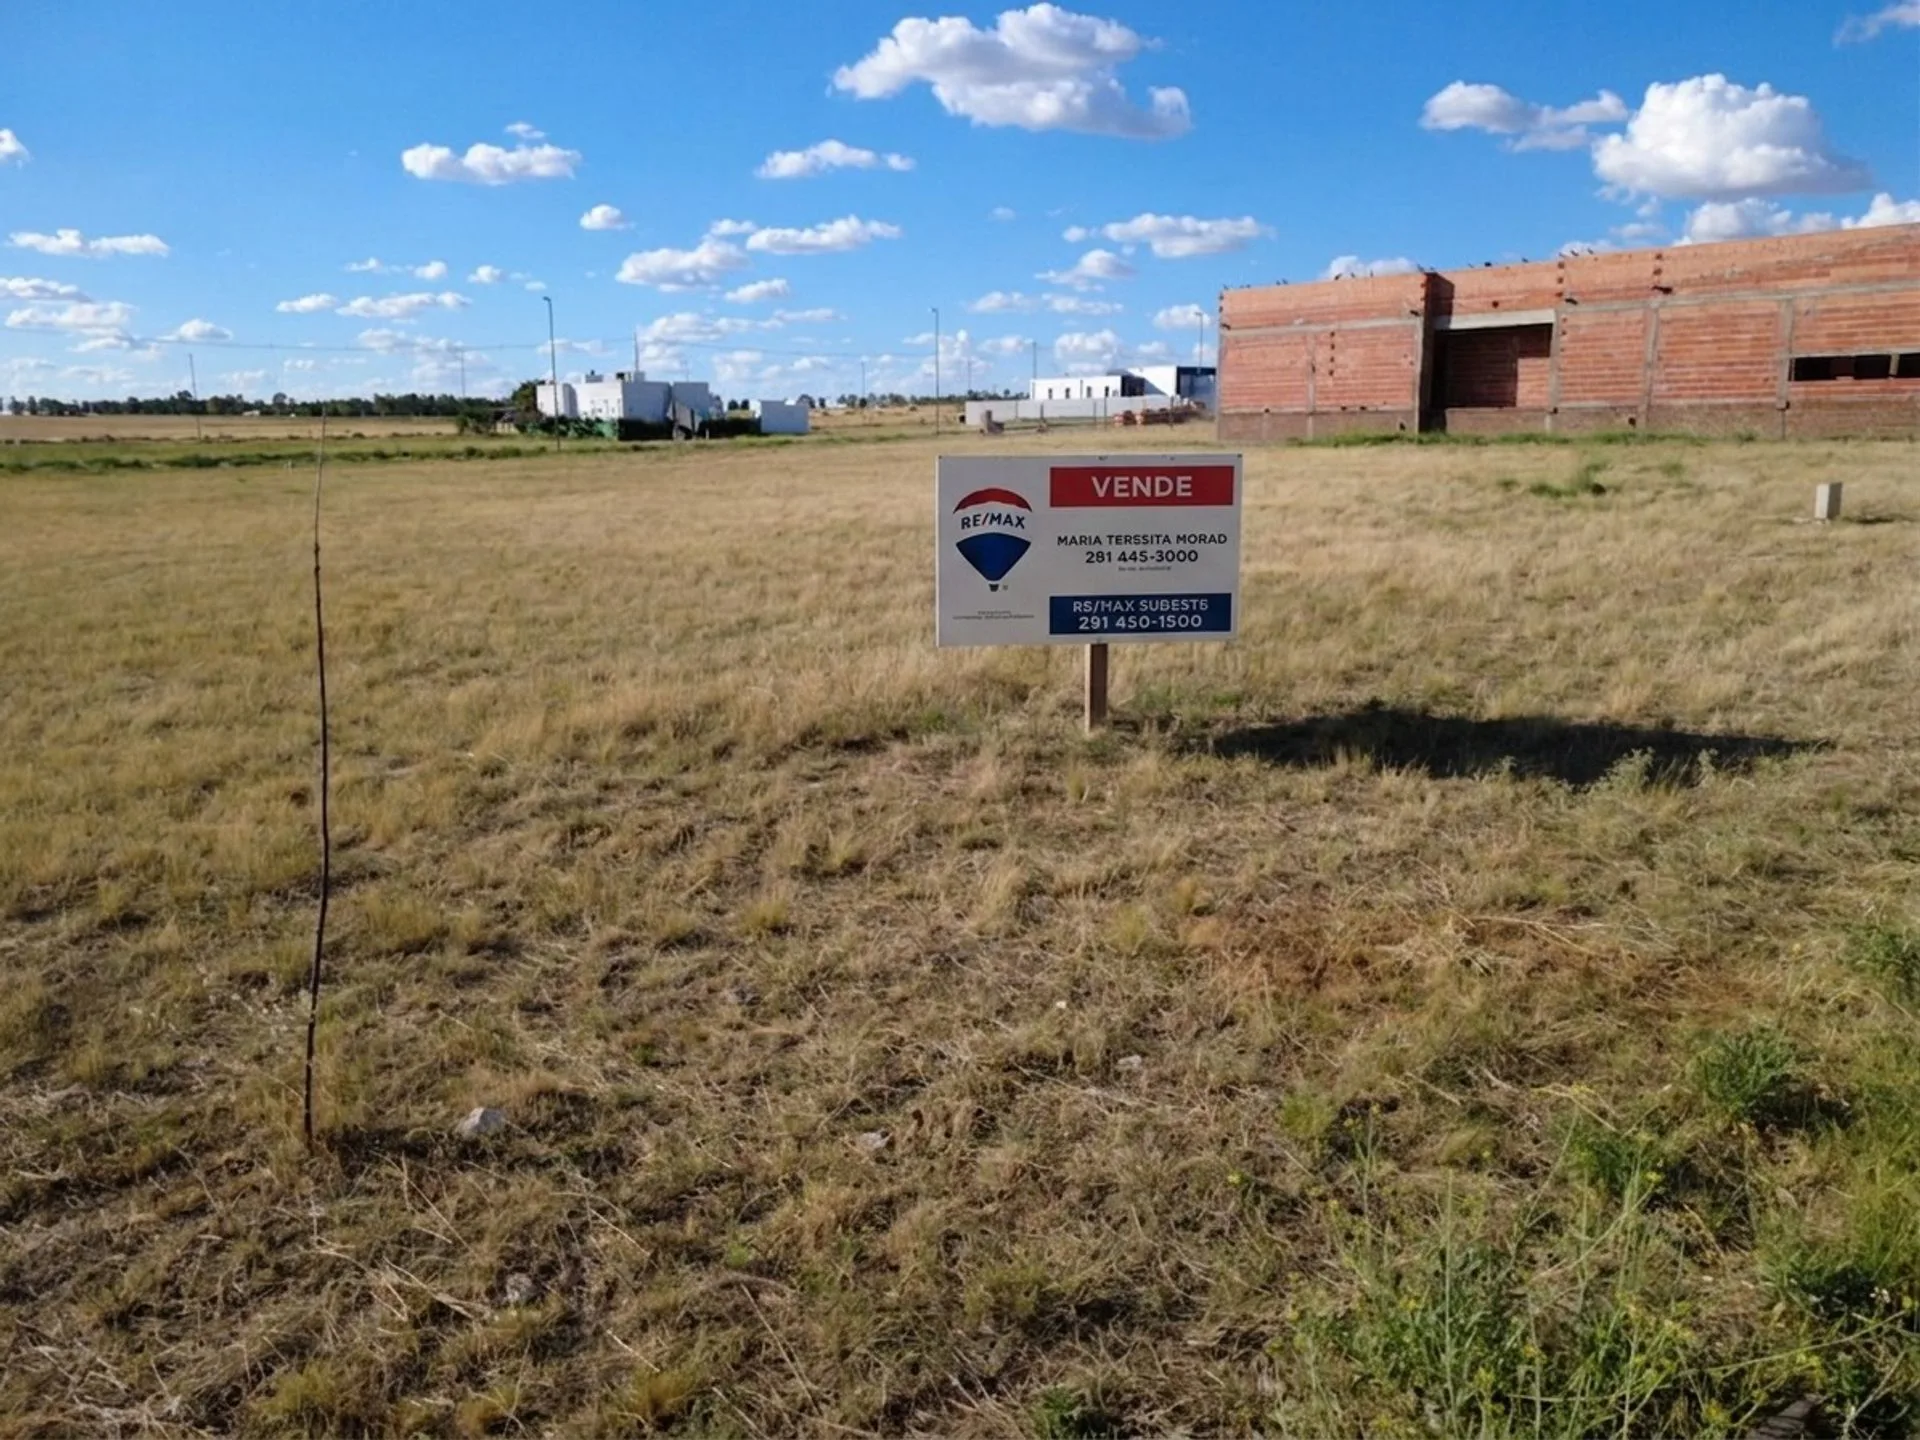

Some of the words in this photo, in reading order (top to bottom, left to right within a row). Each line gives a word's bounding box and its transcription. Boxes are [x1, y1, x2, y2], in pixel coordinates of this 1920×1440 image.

[1091, 475, 1193, 498] VENDE
[960, 512, 1026, 530] RE/MAX
[1057, 535, 1102, 546] MARIA
[1176, 533, 1228, 545] MORAD
[1117, 550, 1199, 563] 445-3000
[1079, 616, 1108, 630] 291
